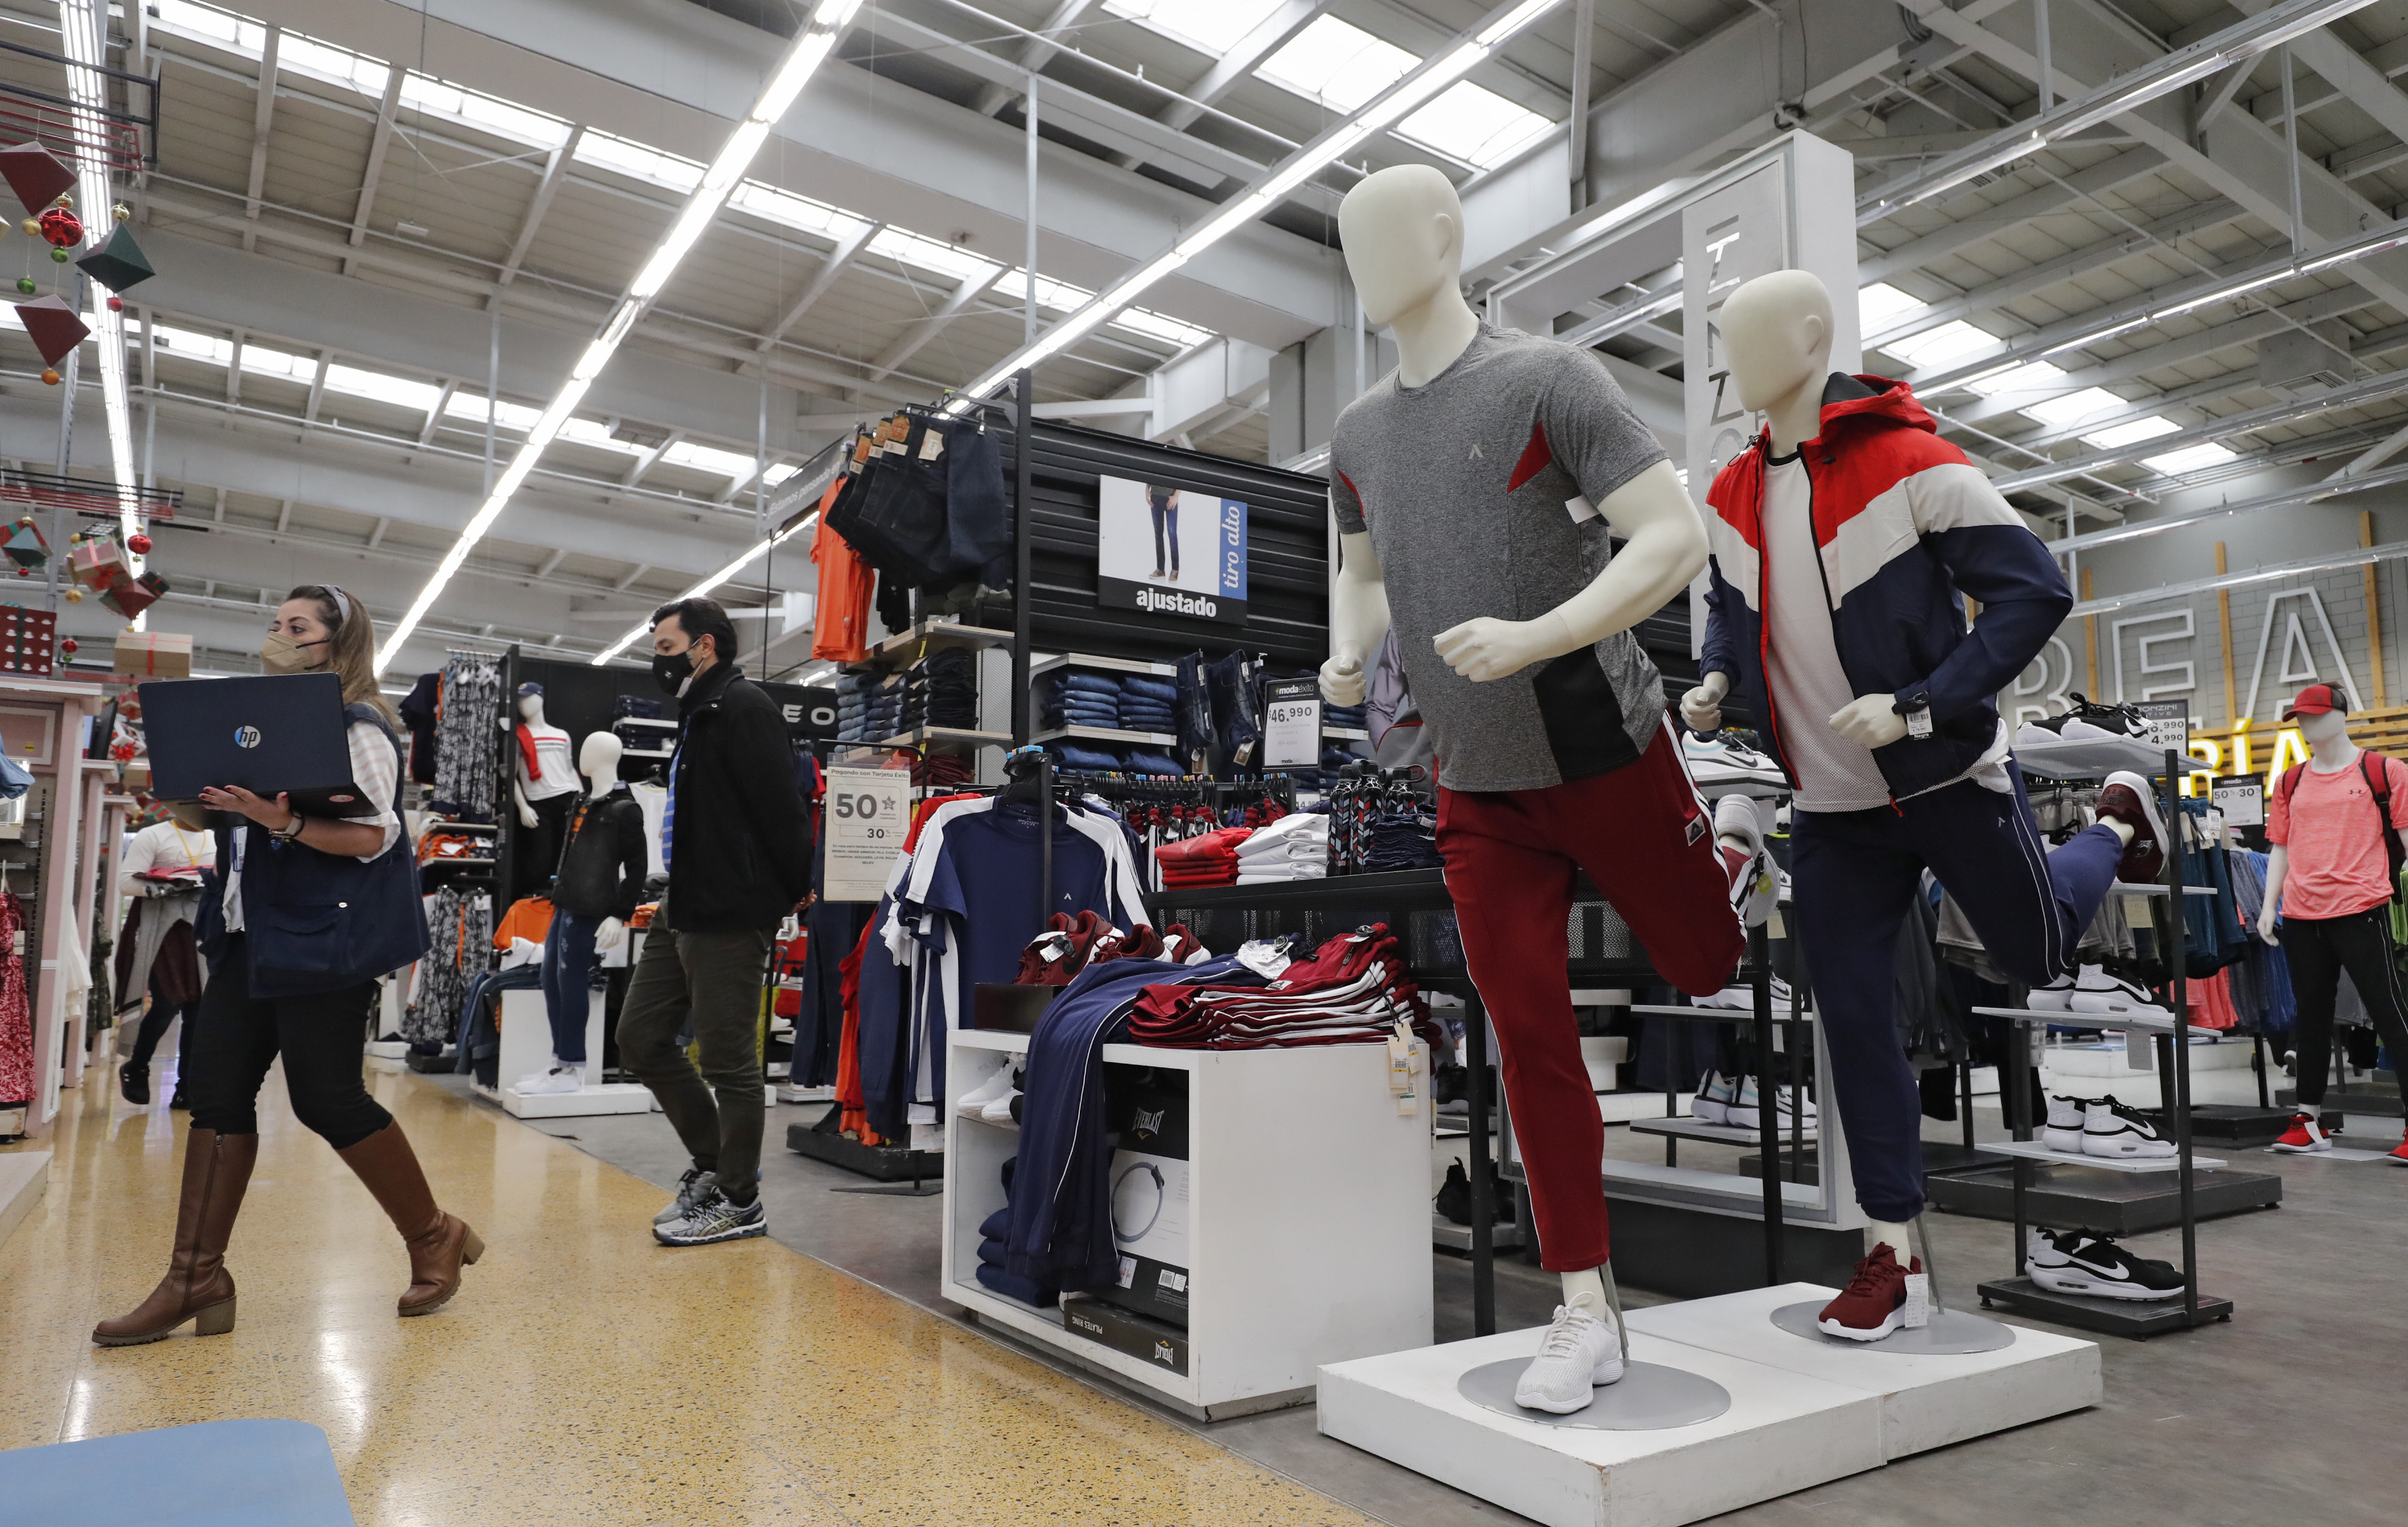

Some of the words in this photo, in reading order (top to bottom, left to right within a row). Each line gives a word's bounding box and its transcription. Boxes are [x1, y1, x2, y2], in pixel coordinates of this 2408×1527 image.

[1221, 505, 1240, 546] alto
[1224, 551, 1240, 589] tiro
[1136, 587, 1217, 618] ajustado
[1268, 707, 1312, 723] $46.990
[236, 725, 259, 748] hp
[835, 793, 877, 820] 50
[867, 828, 885, 839] 30
[1131, 1107, 1164, 1135] EVERLAST
[1072, 1316, 1084, 1326] RING
[1084, 1320, 1103, 1334] PILATES
[1154, 1342, 1174, 1365] EVERLAST
